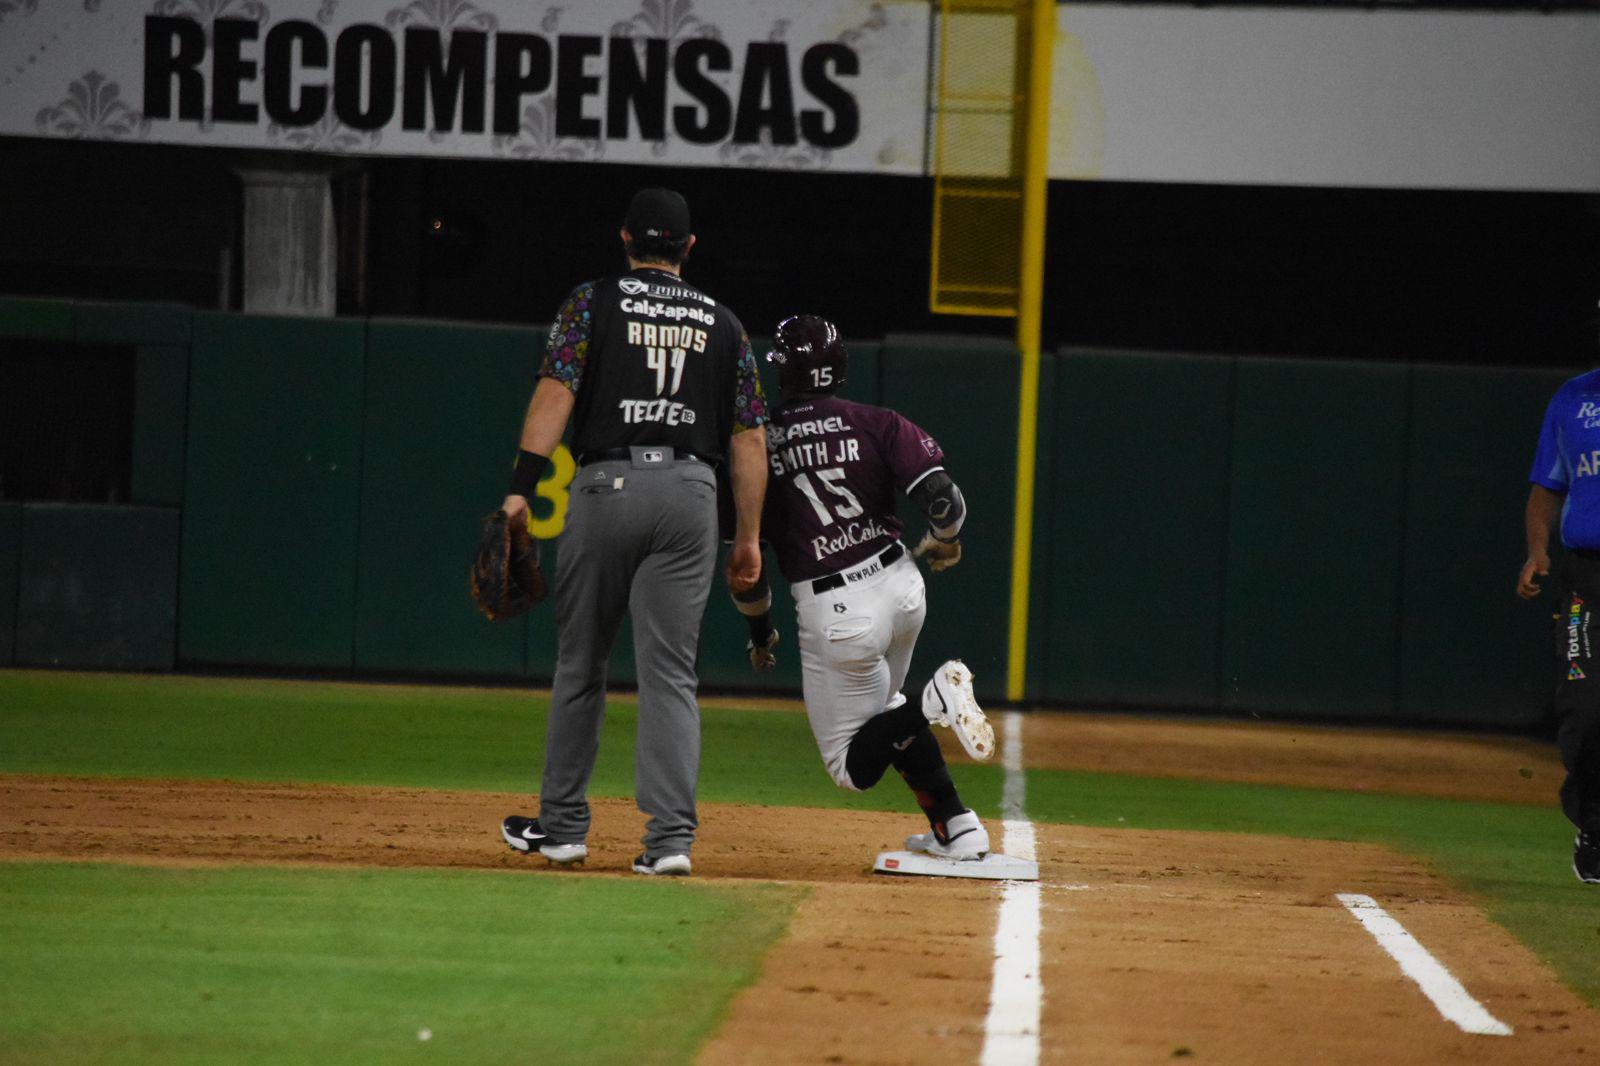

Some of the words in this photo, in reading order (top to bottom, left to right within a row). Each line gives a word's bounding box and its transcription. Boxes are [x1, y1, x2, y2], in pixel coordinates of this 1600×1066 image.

[142, 15, 861, 151] RECOMPENSAS
[620, 298, 715, 326] Calzzapato
[627, 321, 708, 353] RAMOS
[810, 366, 834, 388] 15
[786, 416, 852, 441] ARIEL
[770, 441, 829, 476] SMITH
[836, 438, 861, 464] JR
[793, 467, 864, 527] 15
[846, 570, 864, 583] NEW
